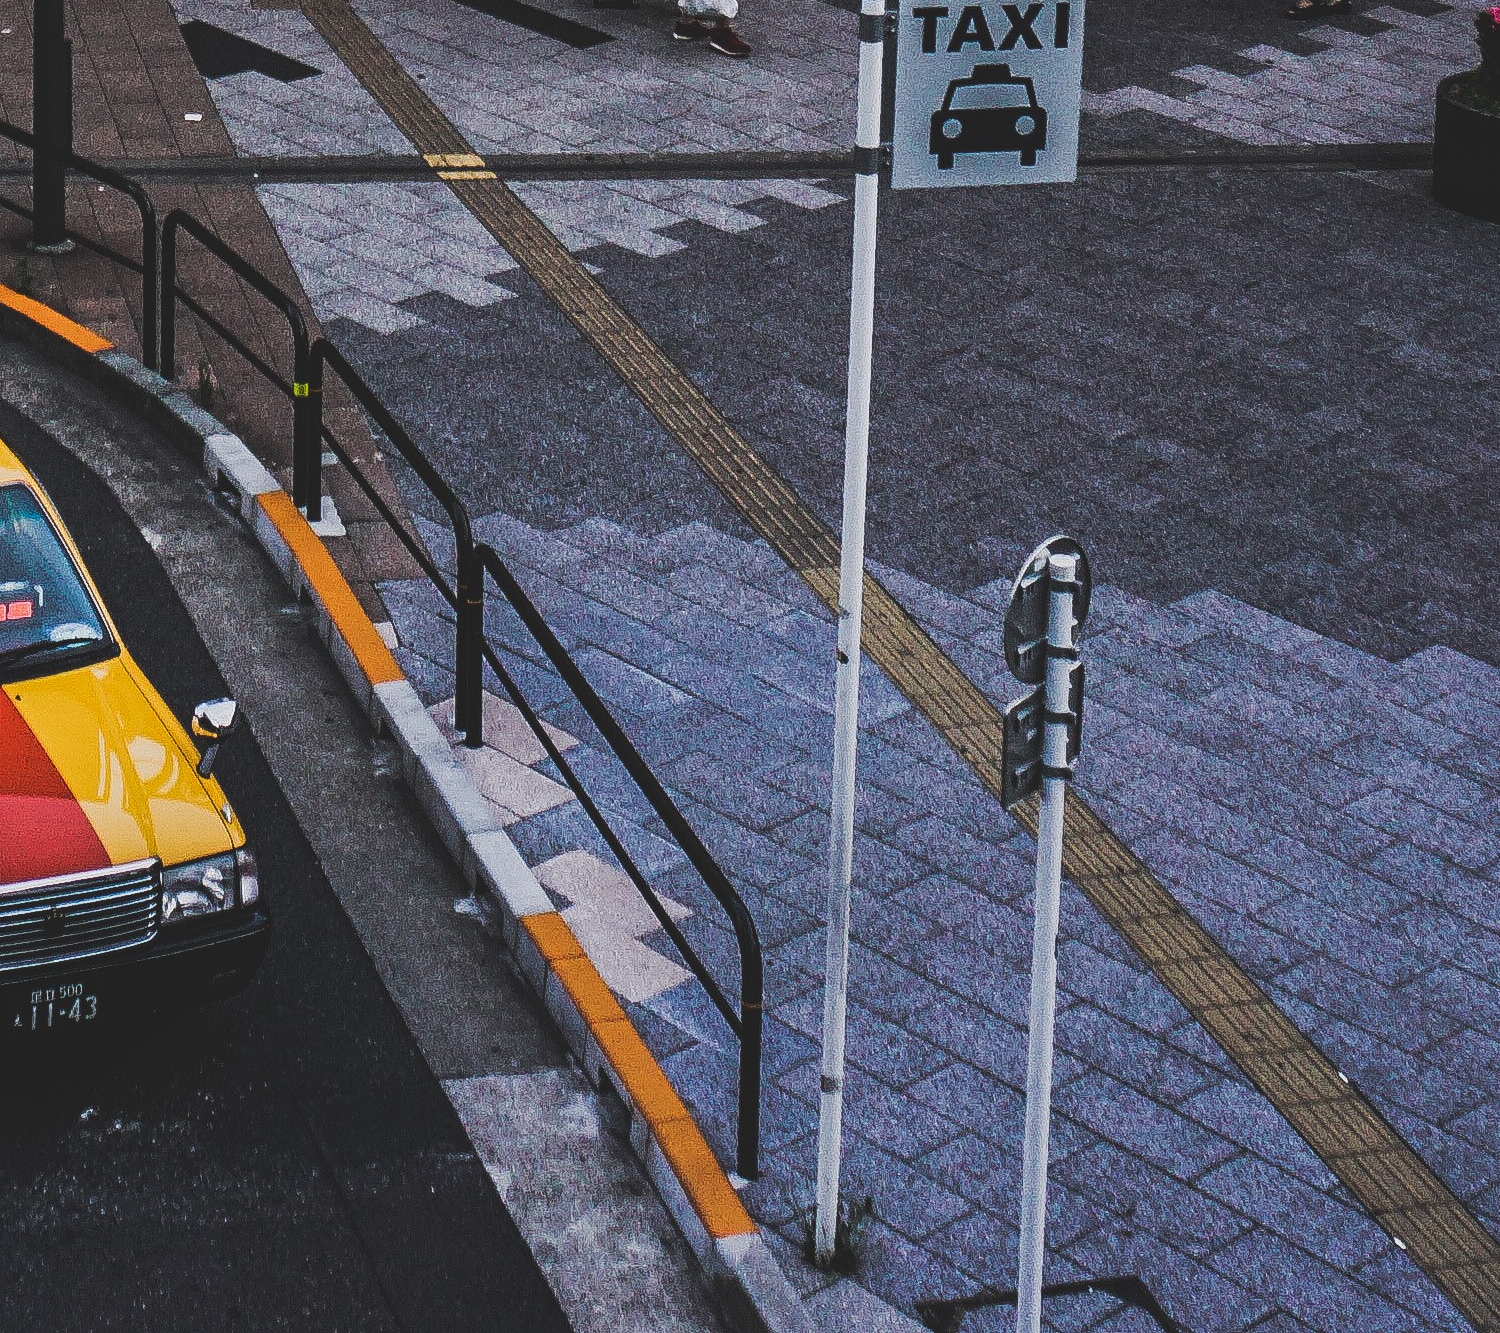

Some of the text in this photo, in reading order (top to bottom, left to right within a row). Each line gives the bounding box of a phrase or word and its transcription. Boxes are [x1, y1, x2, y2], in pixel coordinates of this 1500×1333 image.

[912, 1, 1071, 54] TAXI
[59, 982, 84, 1000] 500
[31, 995, 98, 1031] 11-43
